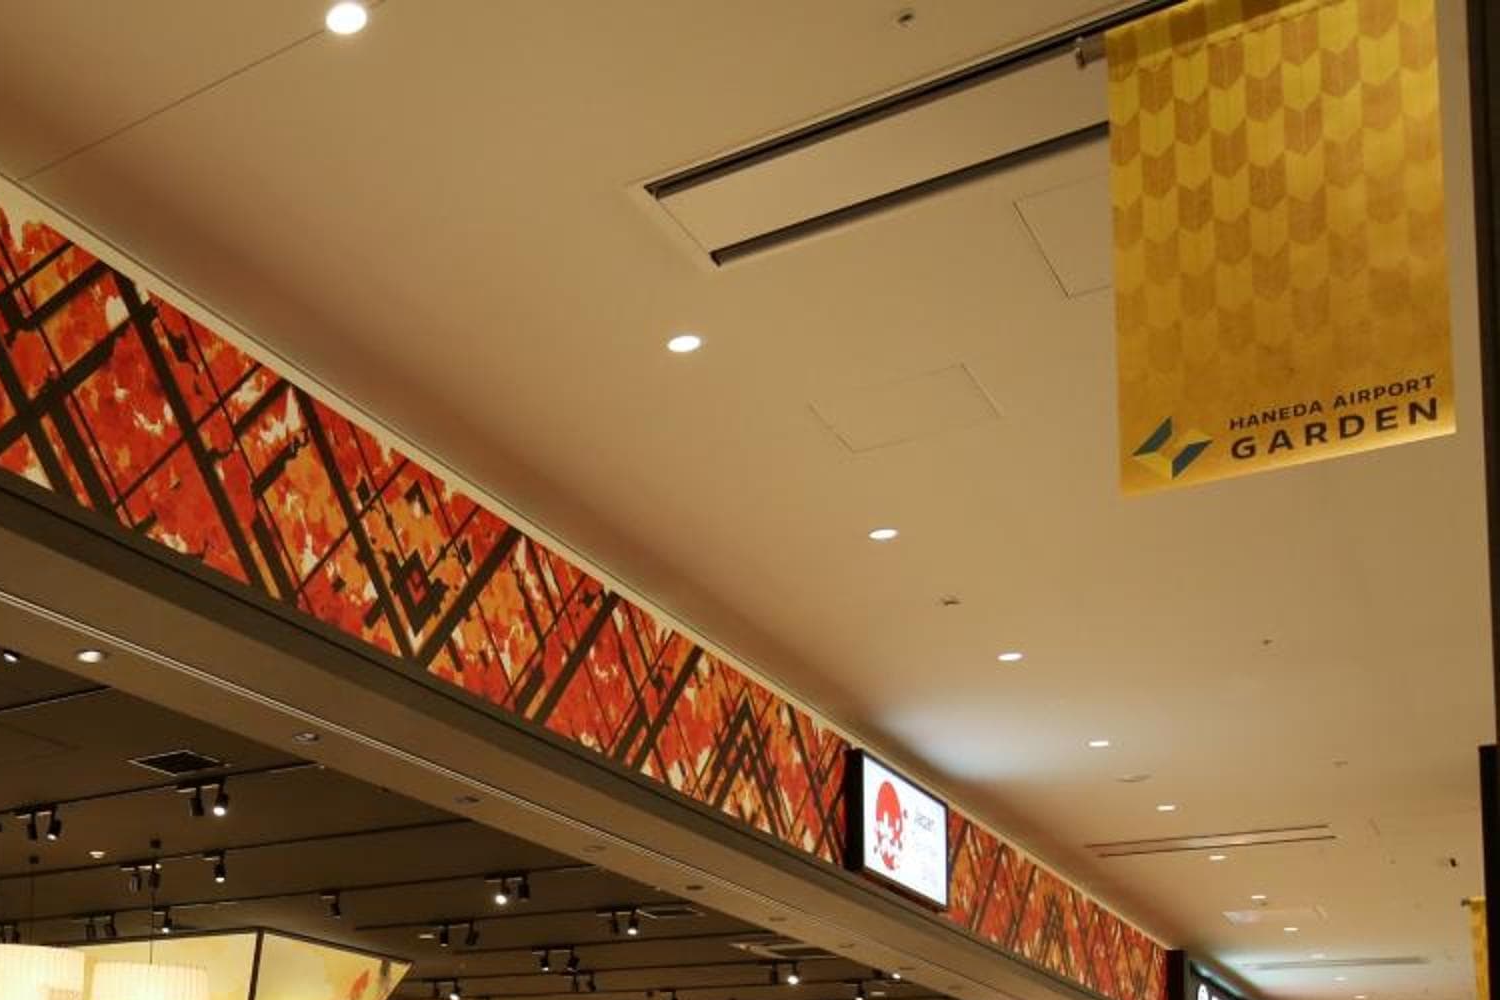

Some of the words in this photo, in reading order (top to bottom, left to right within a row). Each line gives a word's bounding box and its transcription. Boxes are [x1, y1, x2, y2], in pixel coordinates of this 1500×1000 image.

[1229, 401, 1323, 431] HANEDA
[1333, 374, 1435, 410] AIRPORT
[1231, 397, 1439, 461] GARDEN
